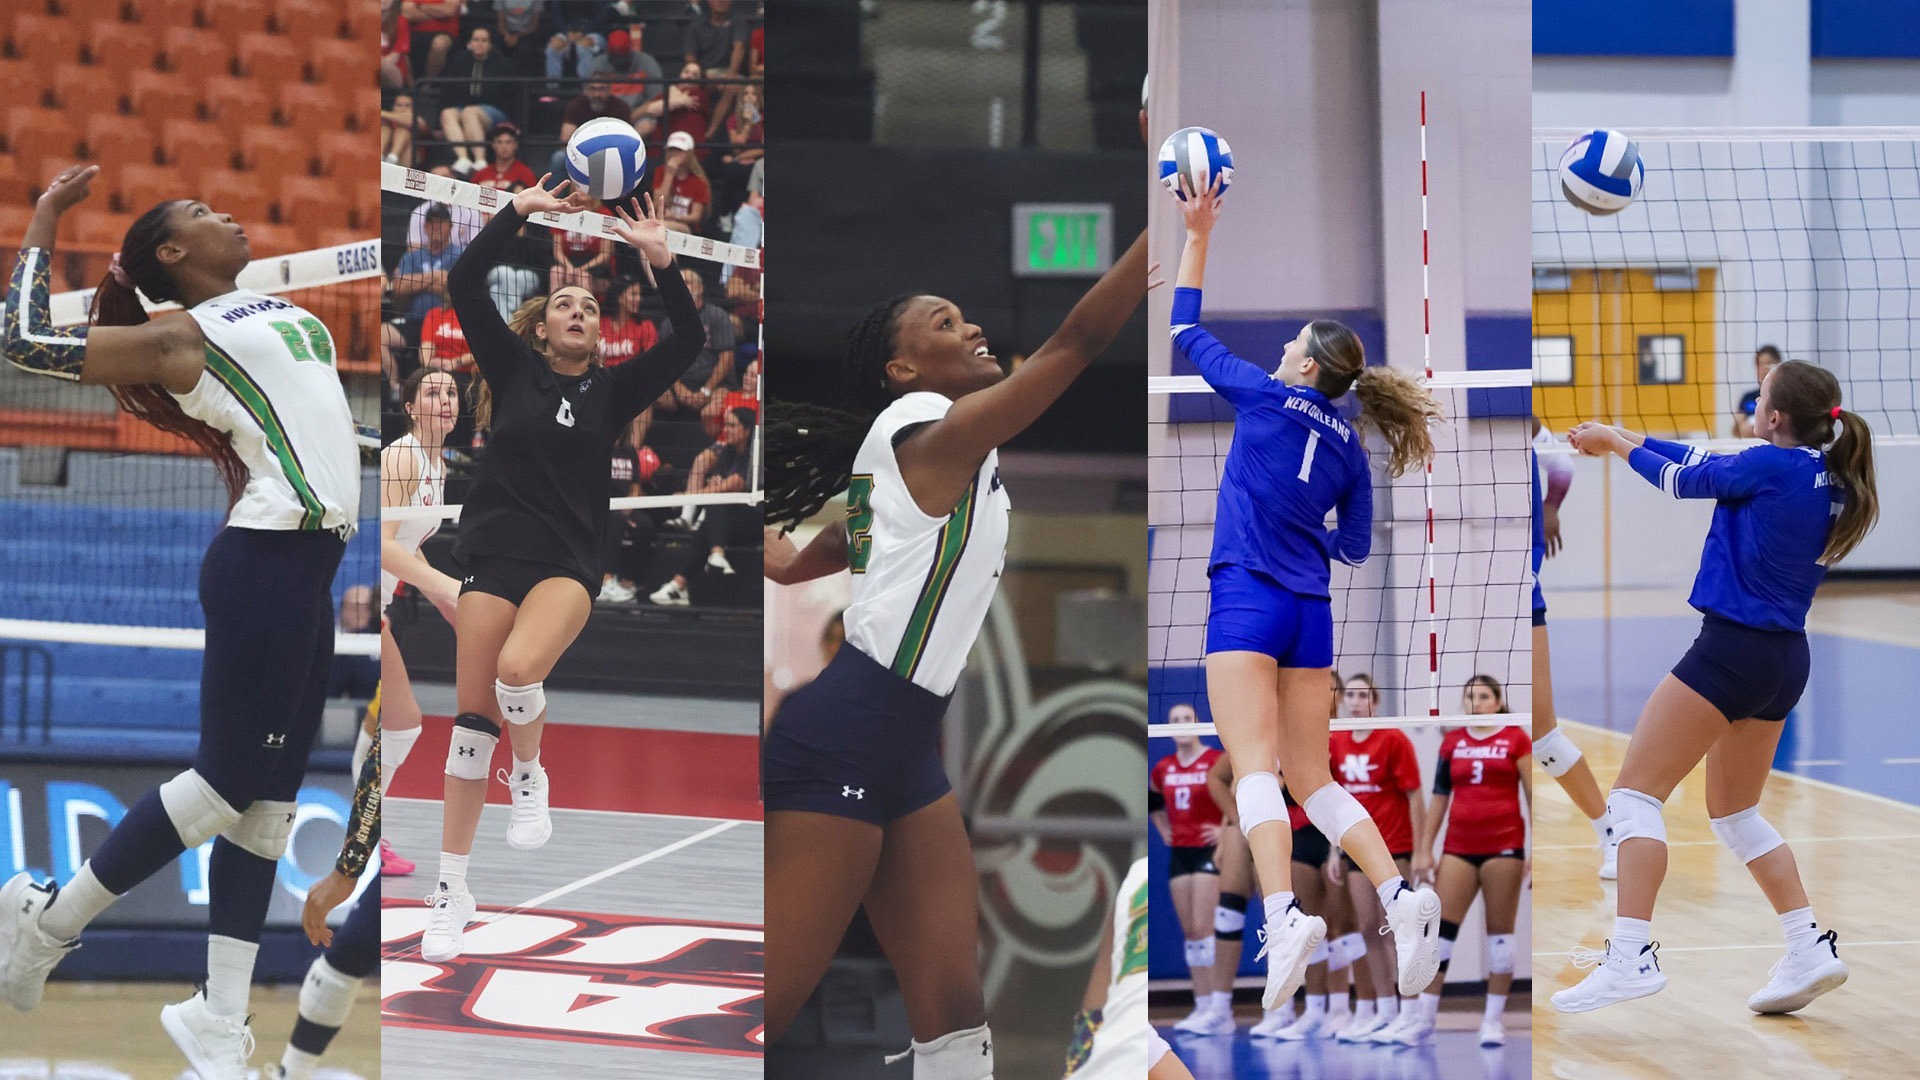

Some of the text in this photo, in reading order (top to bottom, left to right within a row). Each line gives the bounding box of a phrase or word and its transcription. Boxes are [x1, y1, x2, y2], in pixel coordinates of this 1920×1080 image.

[337, 246, 378, 275] BEARS
[1029, 213, 1099, 268] EXIT
[268, 317, 332, 366] 22
[1308, 404, 1350, 444] ORLEANS
[1297, 428, 1321, 483] 1
[1470, 760, 1483, 785] 3
[361, 786, 381, 825] ORLEANS
